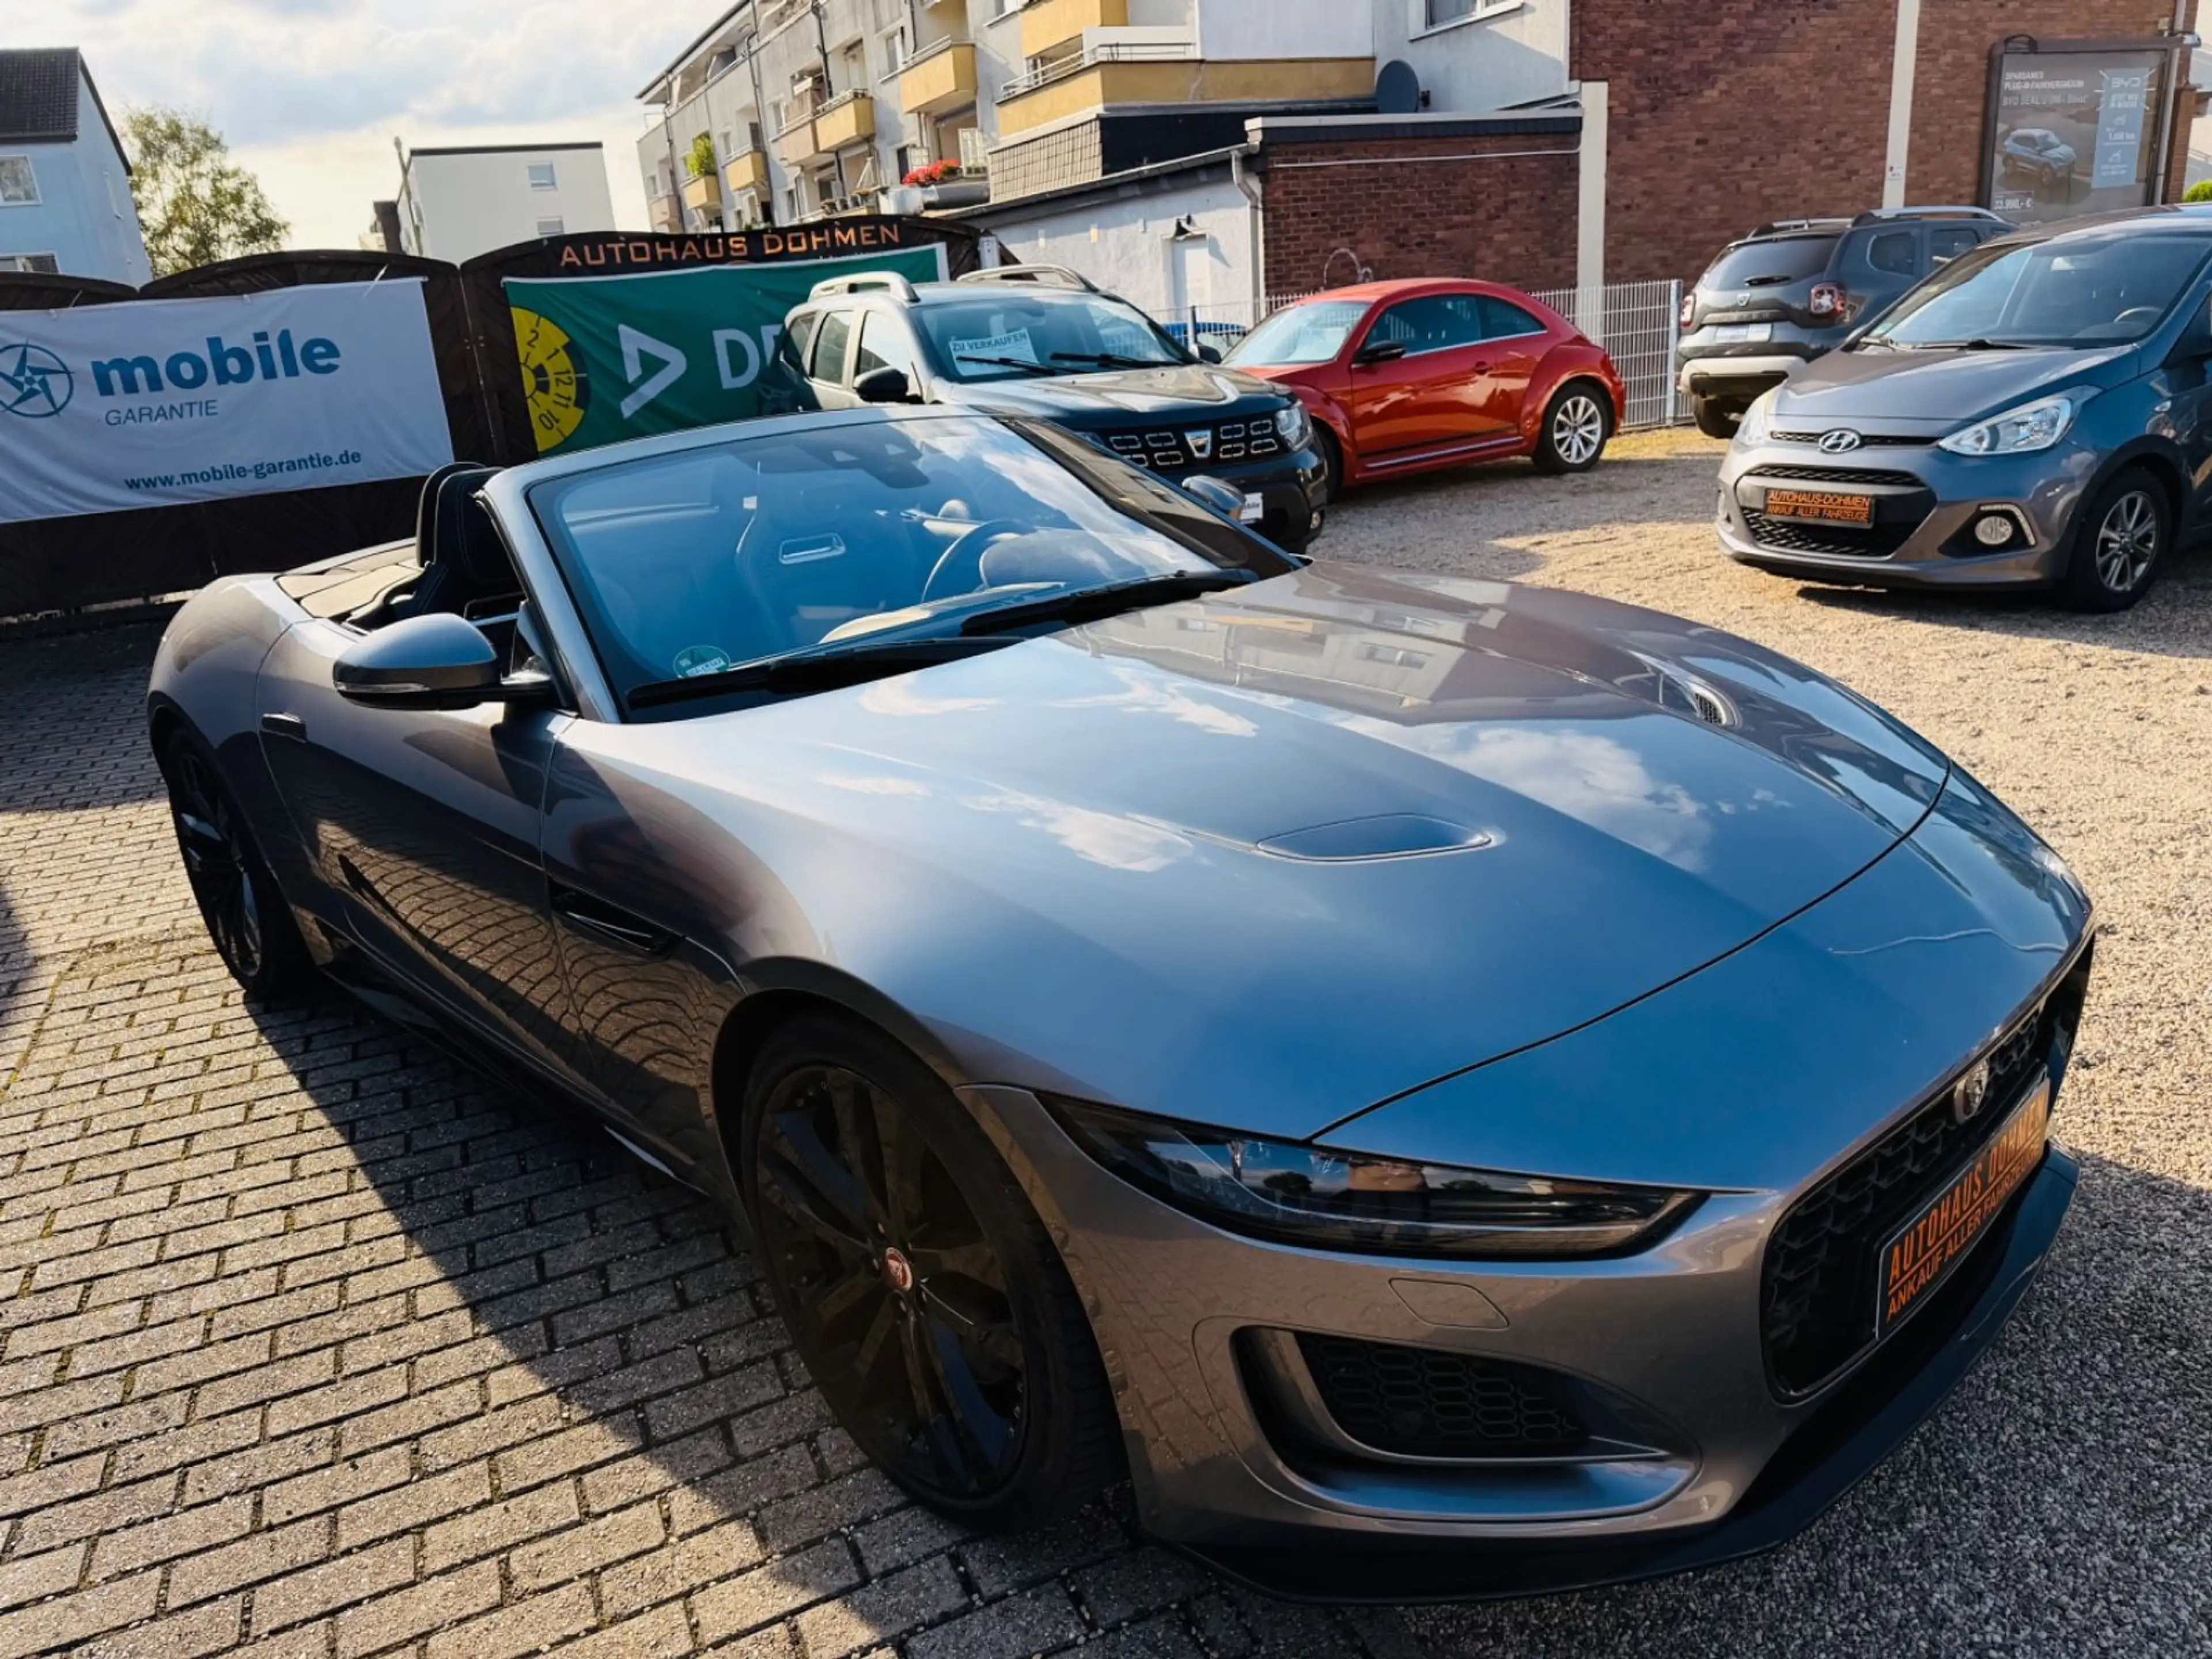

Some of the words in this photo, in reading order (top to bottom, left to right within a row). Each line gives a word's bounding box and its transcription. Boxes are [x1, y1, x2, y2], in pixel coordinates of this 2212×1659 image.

[2111, 77, 2141, 88] BYD
[560, 236, 748, 267] AUTOHAUS
[762, 224, 900, 255] DOHMEN
[527, 329, 540, 348] 2
[90, 328, 341, 396] mobile
[553, 369, 574, 387] 12
[105, 399, 219, 426] GARANTIE
[539, 409, 560, 430] 10
[124, 448, 362, 490] www.mobile-garantie.de
[1888, 1161, 1982, 1286] AUTOHAUS
[1887, 1248, 1944, 1323] ANKAUF
[1944, 1208, 1982, 1263] ALLER
